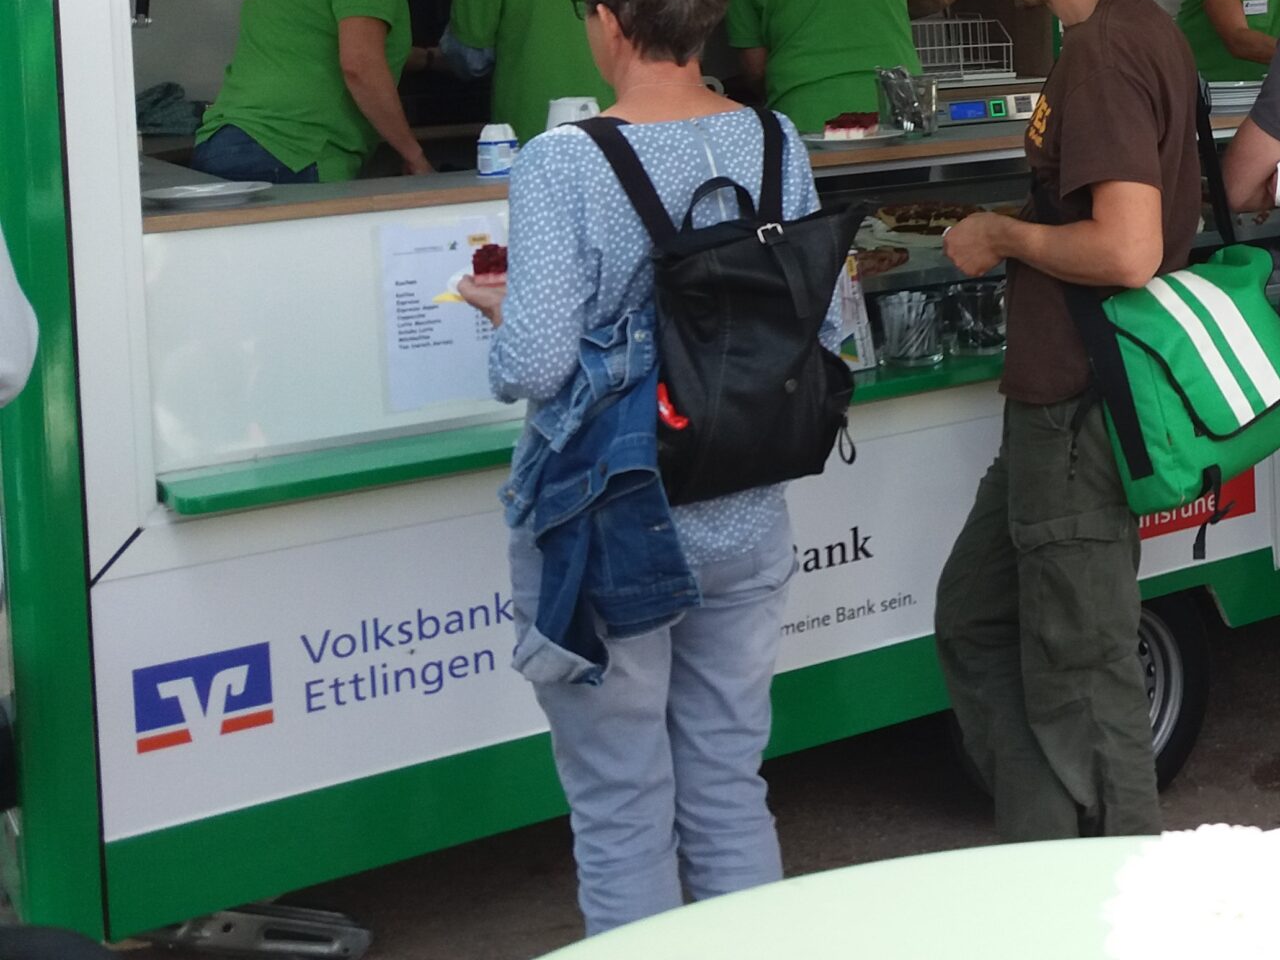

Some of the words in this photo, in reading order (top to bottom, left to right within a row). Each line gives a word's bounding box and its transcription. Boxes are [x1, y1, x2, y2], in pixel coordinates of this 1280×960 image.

[793, 525, 874, 573] ank
[300, 592, 515, 664] Volksbank
[835, 599, 876, 623] Bank
[880, 592, 917, 612] sein.
[305, 648, 495, 714] Ettlingen
